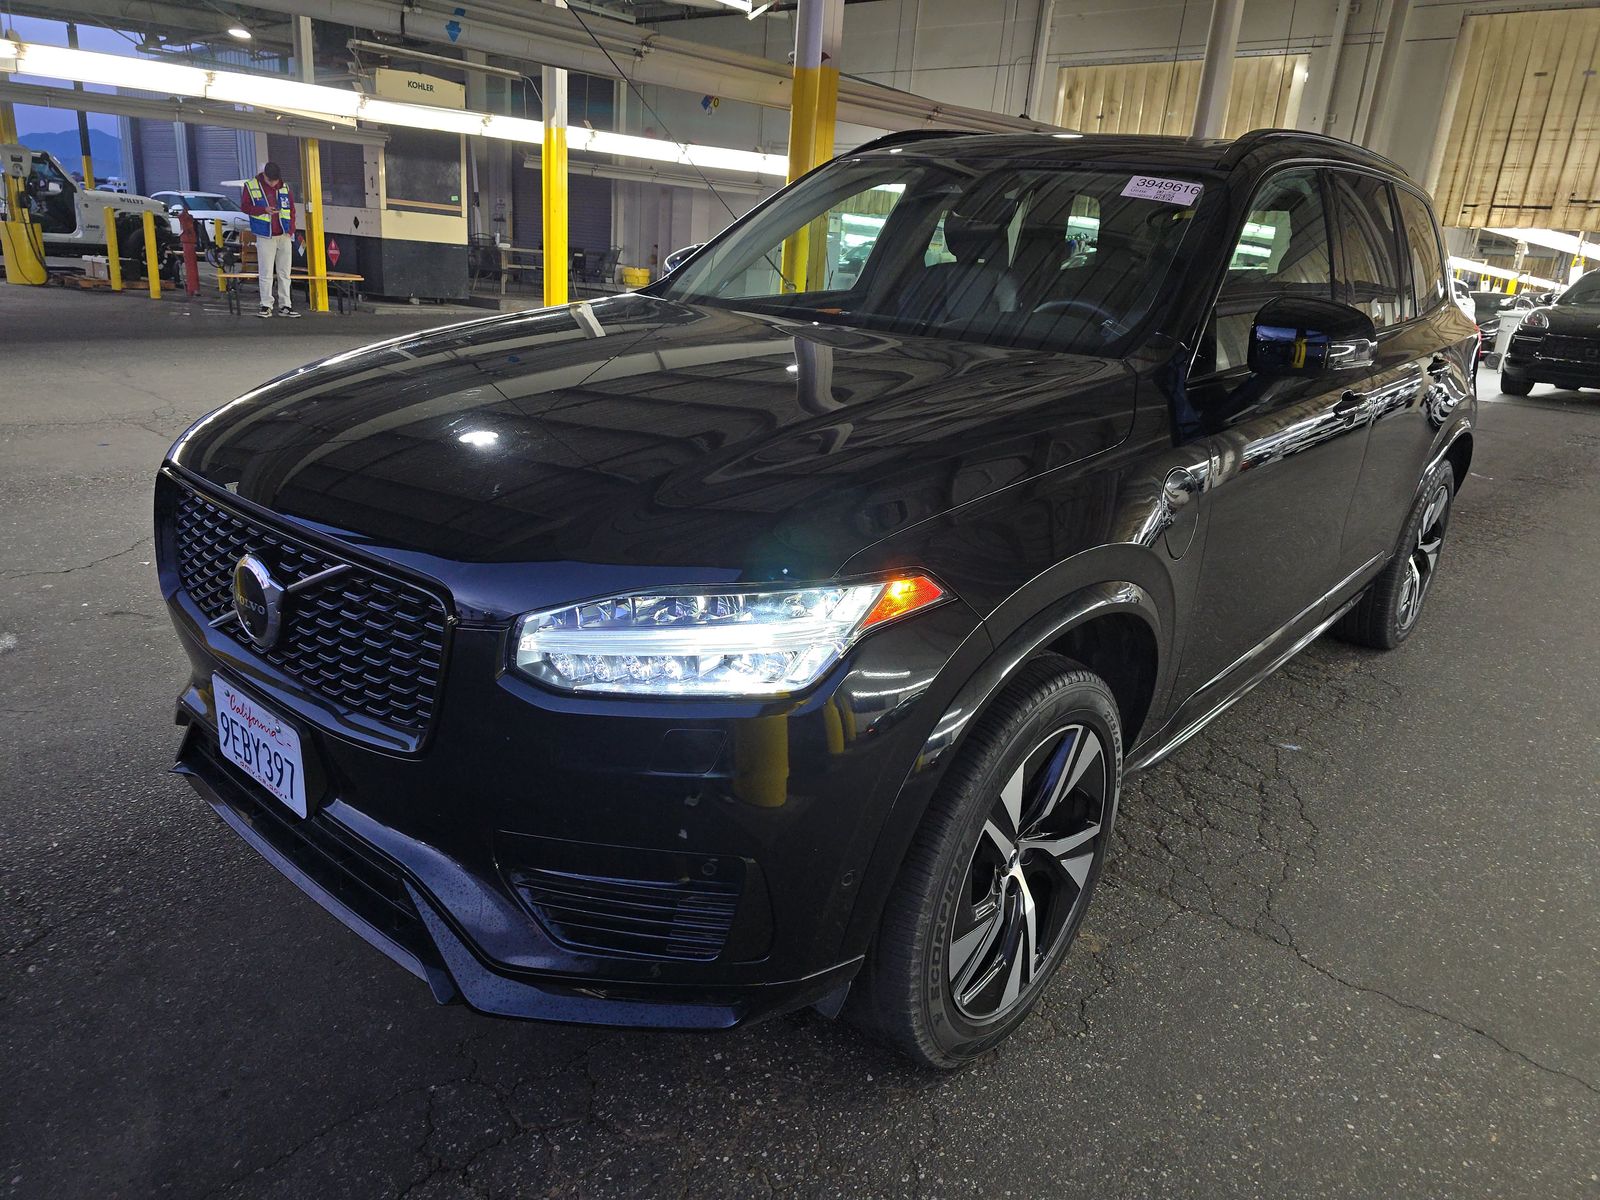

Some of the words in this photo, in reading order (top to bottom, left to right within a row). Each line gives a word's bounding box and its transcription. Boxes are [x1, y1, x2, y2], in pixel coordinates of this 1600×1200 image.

[407, 80, 435, 92] KOHLER
[1136, 178, 1201, 195] 3949616
[236, 593, 266, 615] VOLVO
[229, 694, 284, 746] California
[220, 711, 295, 800] 9EBY397
[929, 842, 968, 1000] SCORPION
